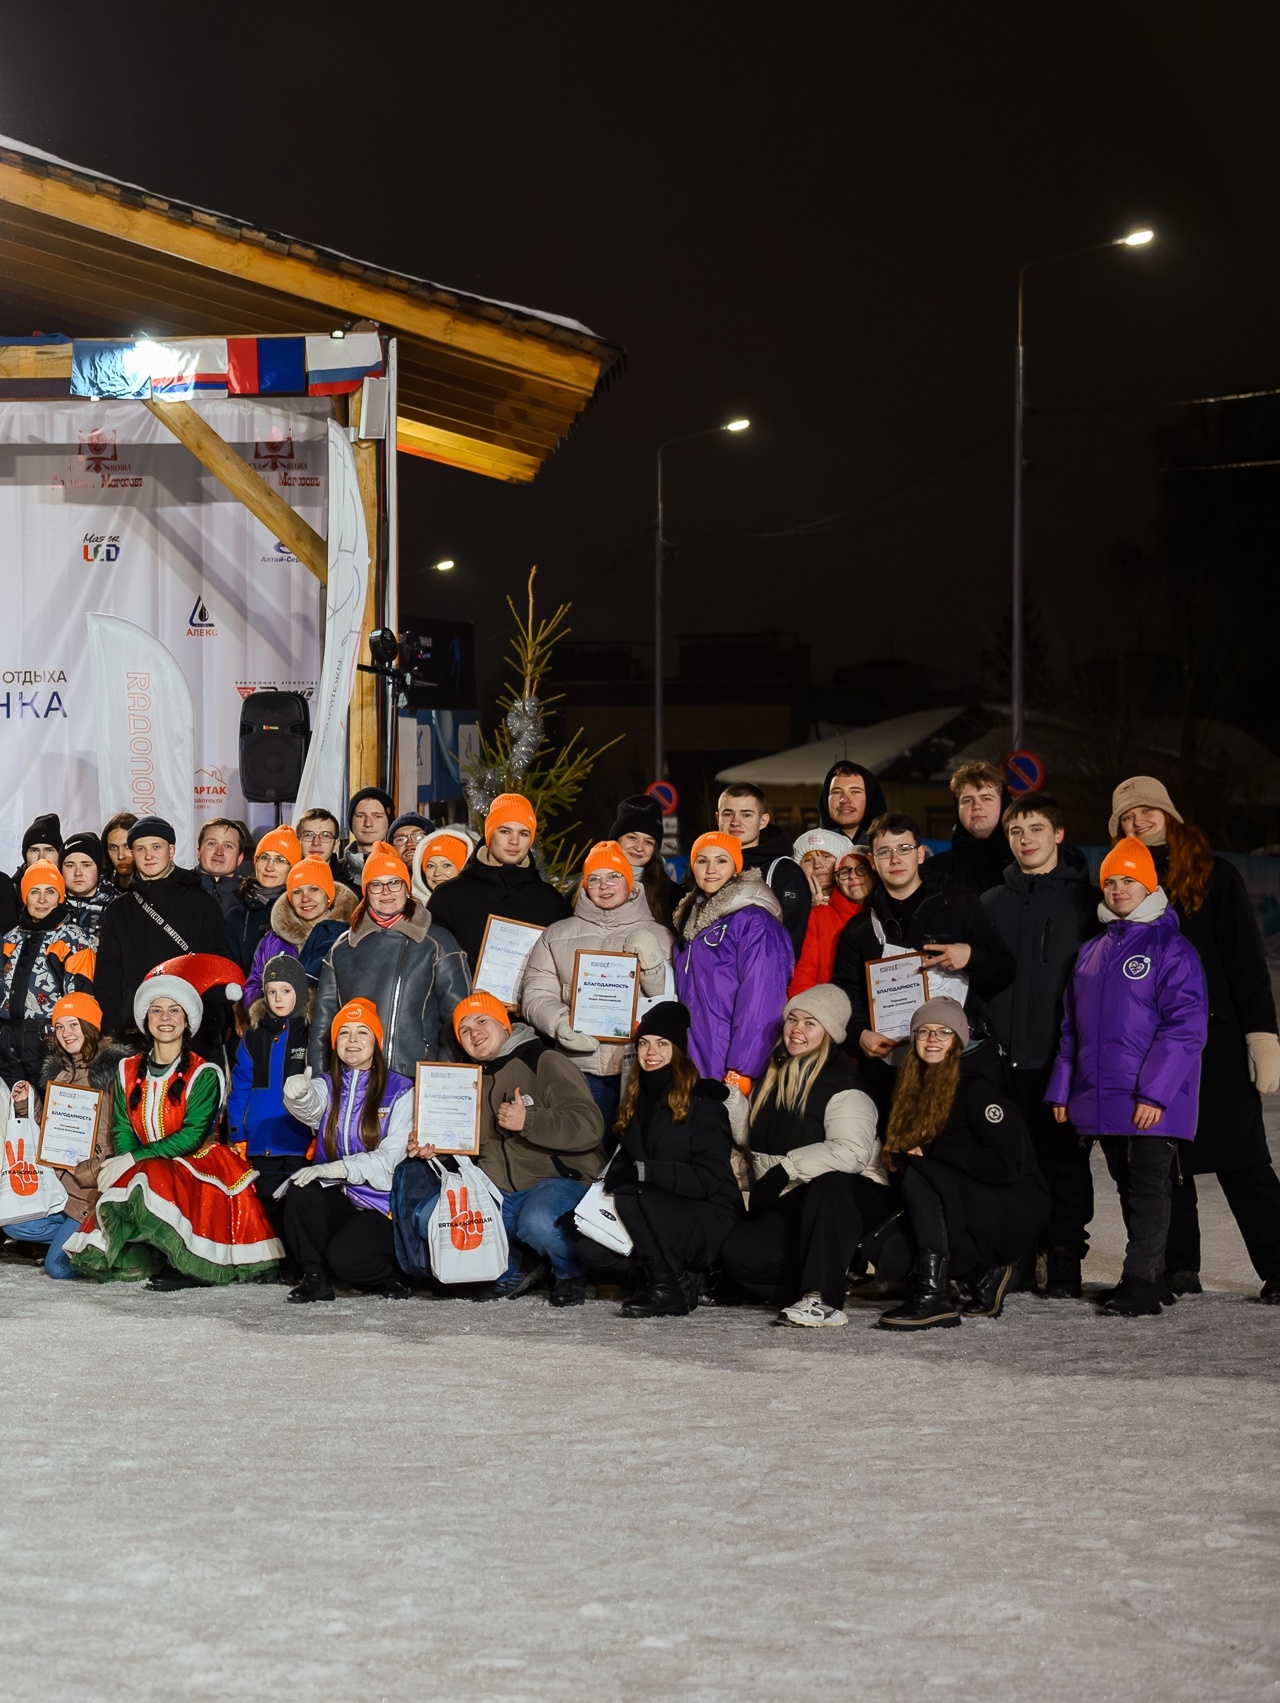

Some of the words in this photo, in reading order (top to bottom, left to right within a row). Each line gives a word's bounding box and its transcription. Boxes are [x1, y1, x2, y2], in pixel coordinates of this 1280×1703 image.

[260, 555, 301, 564] Алтай-Сер
[185, 628, 219, 637] АЛЕКС
[1, 669, 68, 686] ОТДЫХА
[193, 786, 227, 795] АРТАК
[583, 981, 629, 989] БЛАГОДАРНОСТЬ
[876, 982, 921, 995] БЛАГОДАРНОСТЬ
[423, 1093, 473, 1101] БЛАГОДАРНОСТЬ
[51, 1110, 92, 1122] БЛАГОДАРНОСТЬ
